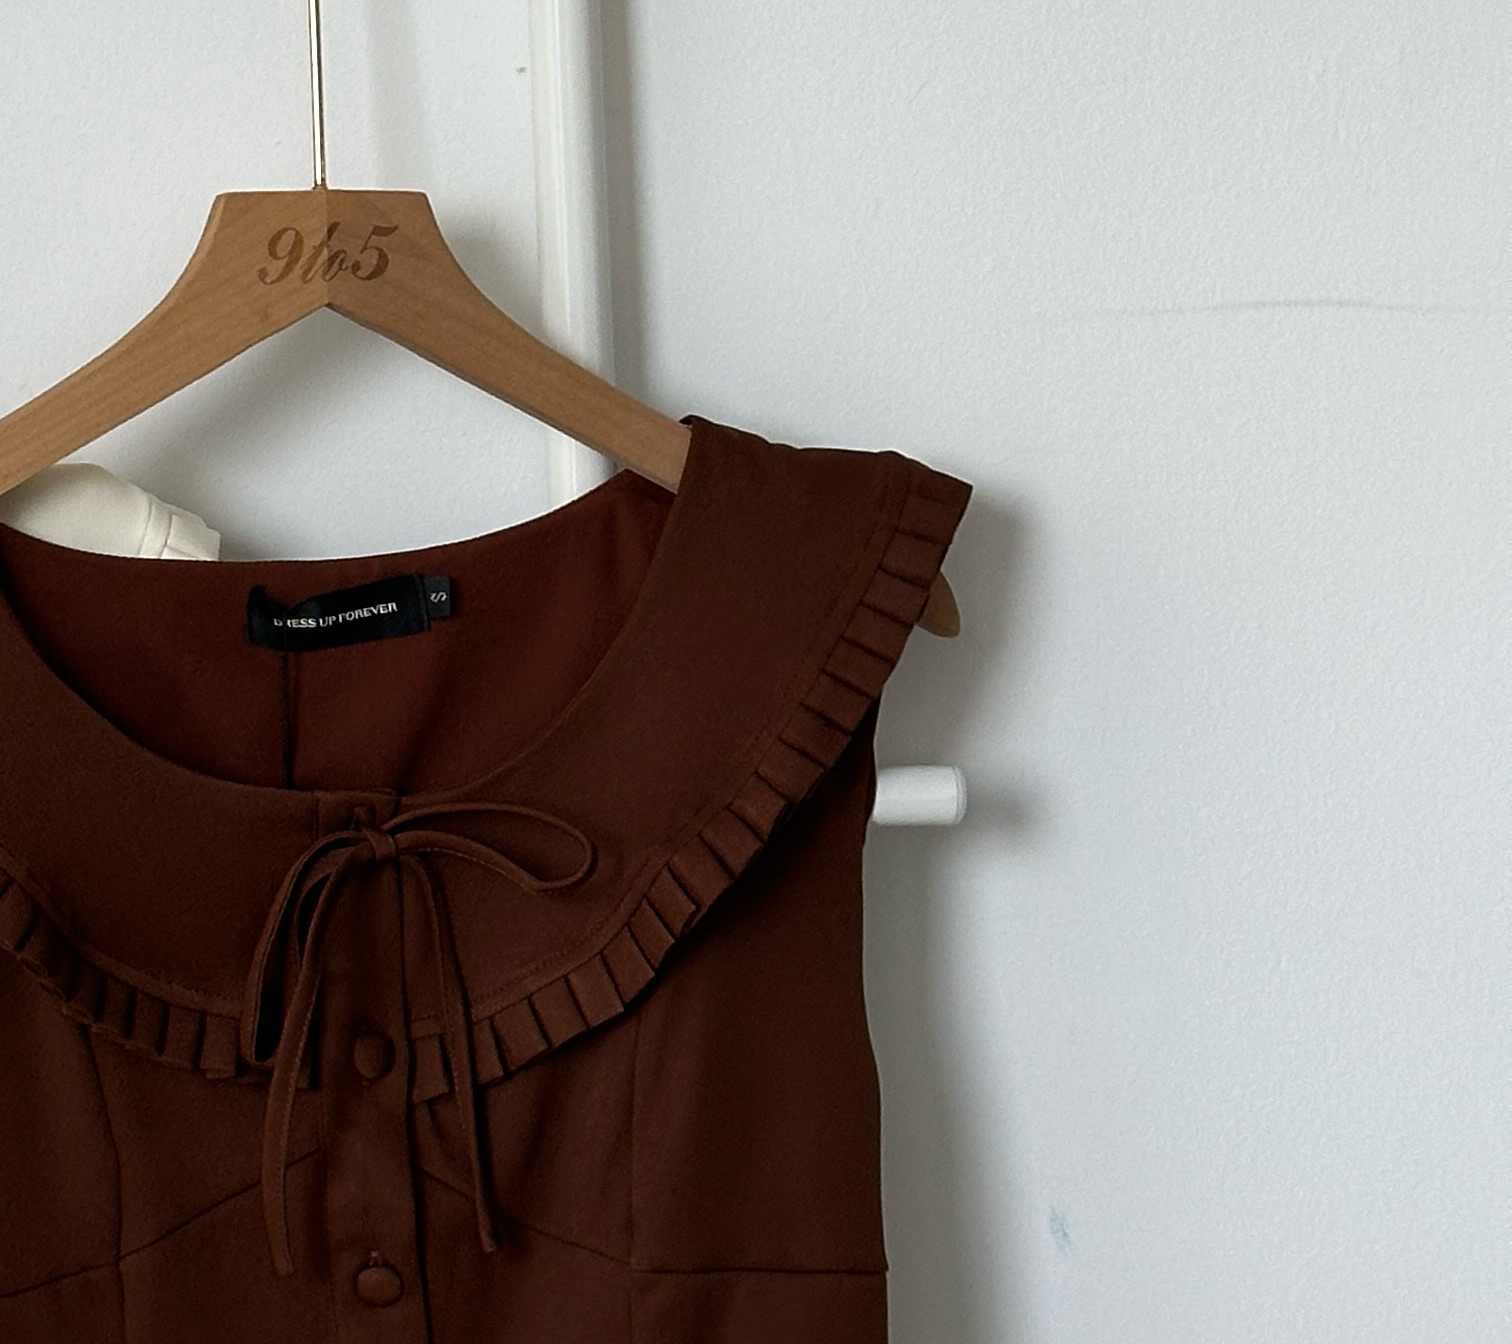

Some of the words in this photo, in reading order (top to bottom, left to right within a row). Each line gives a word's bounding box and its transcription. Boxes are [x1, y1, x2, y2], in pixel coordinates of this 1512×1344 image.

[257, 221, 399, 286] 9to5
[318, 615, 337, 627] UP
[338, 602, 398, 624] FOREVER
